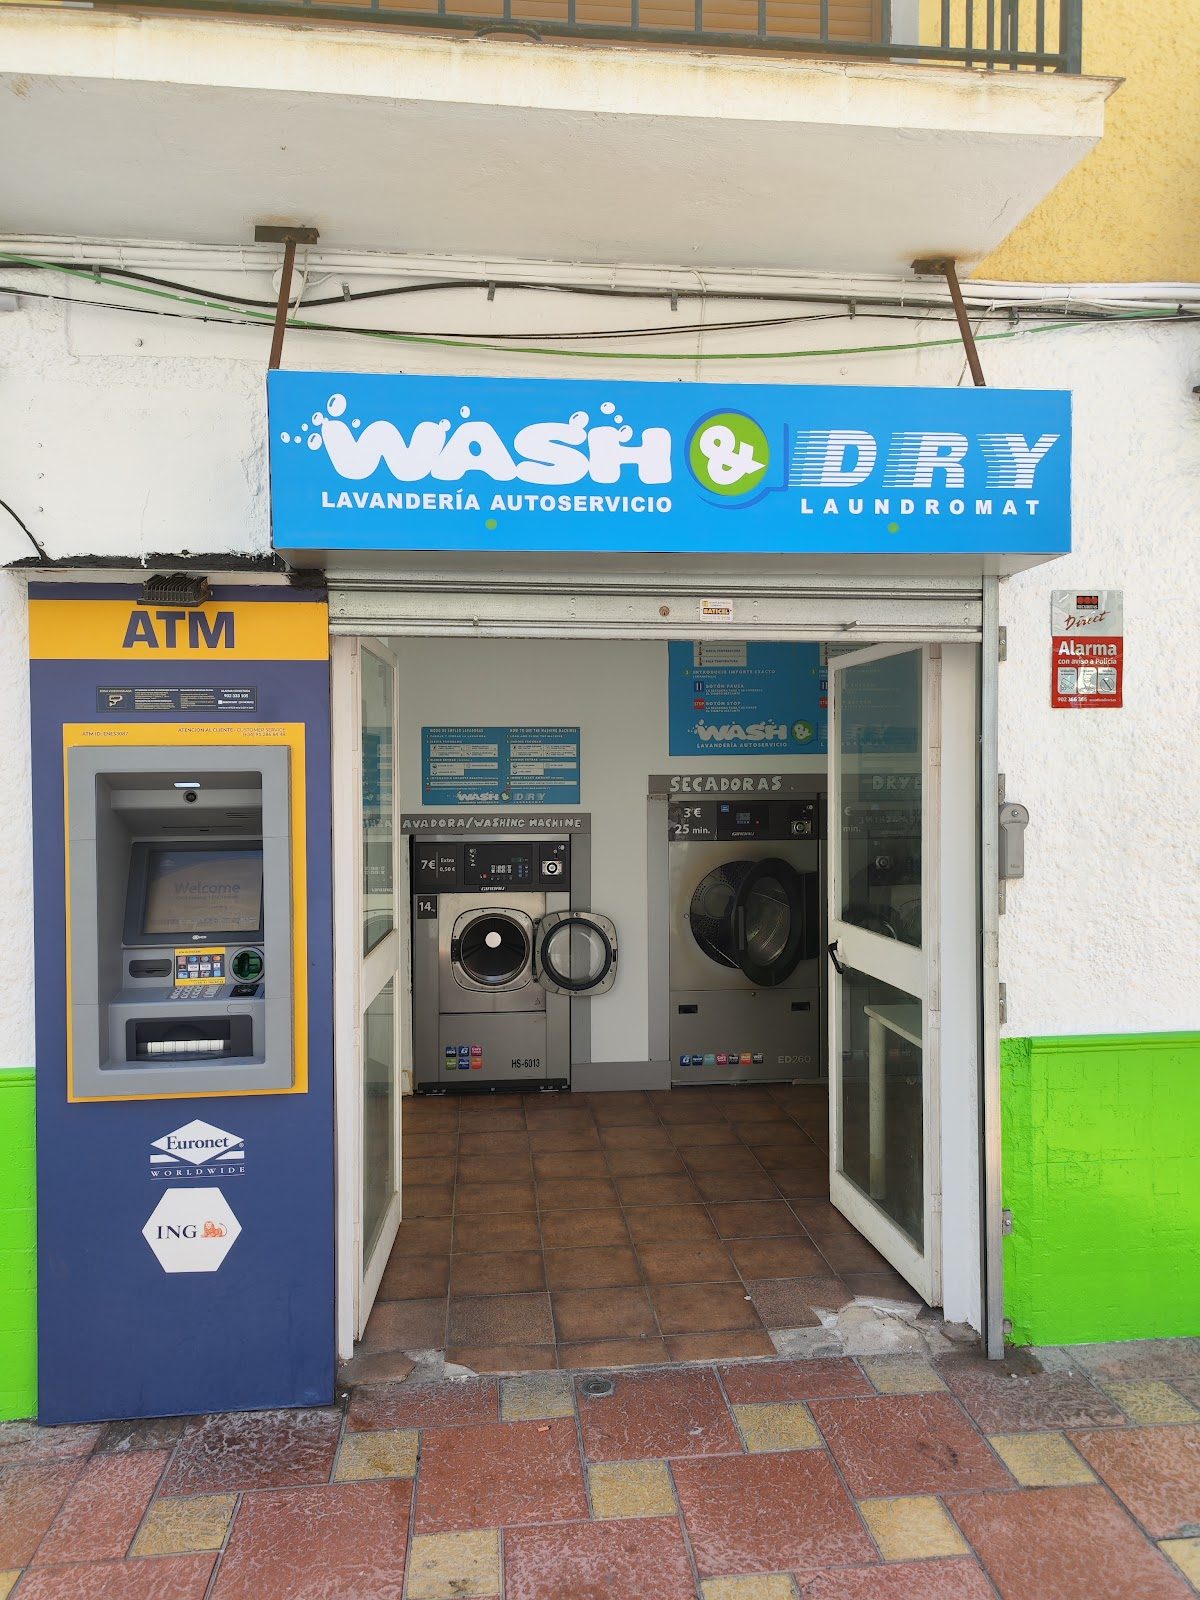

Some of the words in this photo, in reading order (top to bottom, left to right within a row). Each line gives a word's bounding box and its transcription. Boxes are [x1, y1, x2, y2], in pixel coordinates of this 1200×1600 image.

[321, 419, 672, 486] WASH
[699, 425, 766, 485] &
[787, 429, 1061, 489] DRY
[321, 488, 480, 511] LAVANDERÍA
[490, 494, 672, 513] AUTOSERVICIO
[801, 498, 1040, 516] LAUNDROMAT
[1064, 611, 1110, 631] Direct
[122, 610, 235, 649] ATM
[1058, 639, 1117, 656] Alarma
[698, 723, 788, 740] WASH
[669, 776, 783, 791] SECADORAS
[458, 792, 499, 800] WASH
[529, 818, 582, 829] MACHINE
[674, 824, 690, 834] 25
[692, 826, 711, 834] min.
[420, 860, 436, 870] 7€
[175, 880, 241, 894] Welcome
[418, 902, 431, 911] 14
[511, 1058, 540, 1068] HS-6013
[777, 1055, 811, 1064] ED260
[166, 1136, 229, 1150] Euronet
[150, 1166, 245, 1177] WORLDWIDE
[156, 1225, 197, 1239] ING
